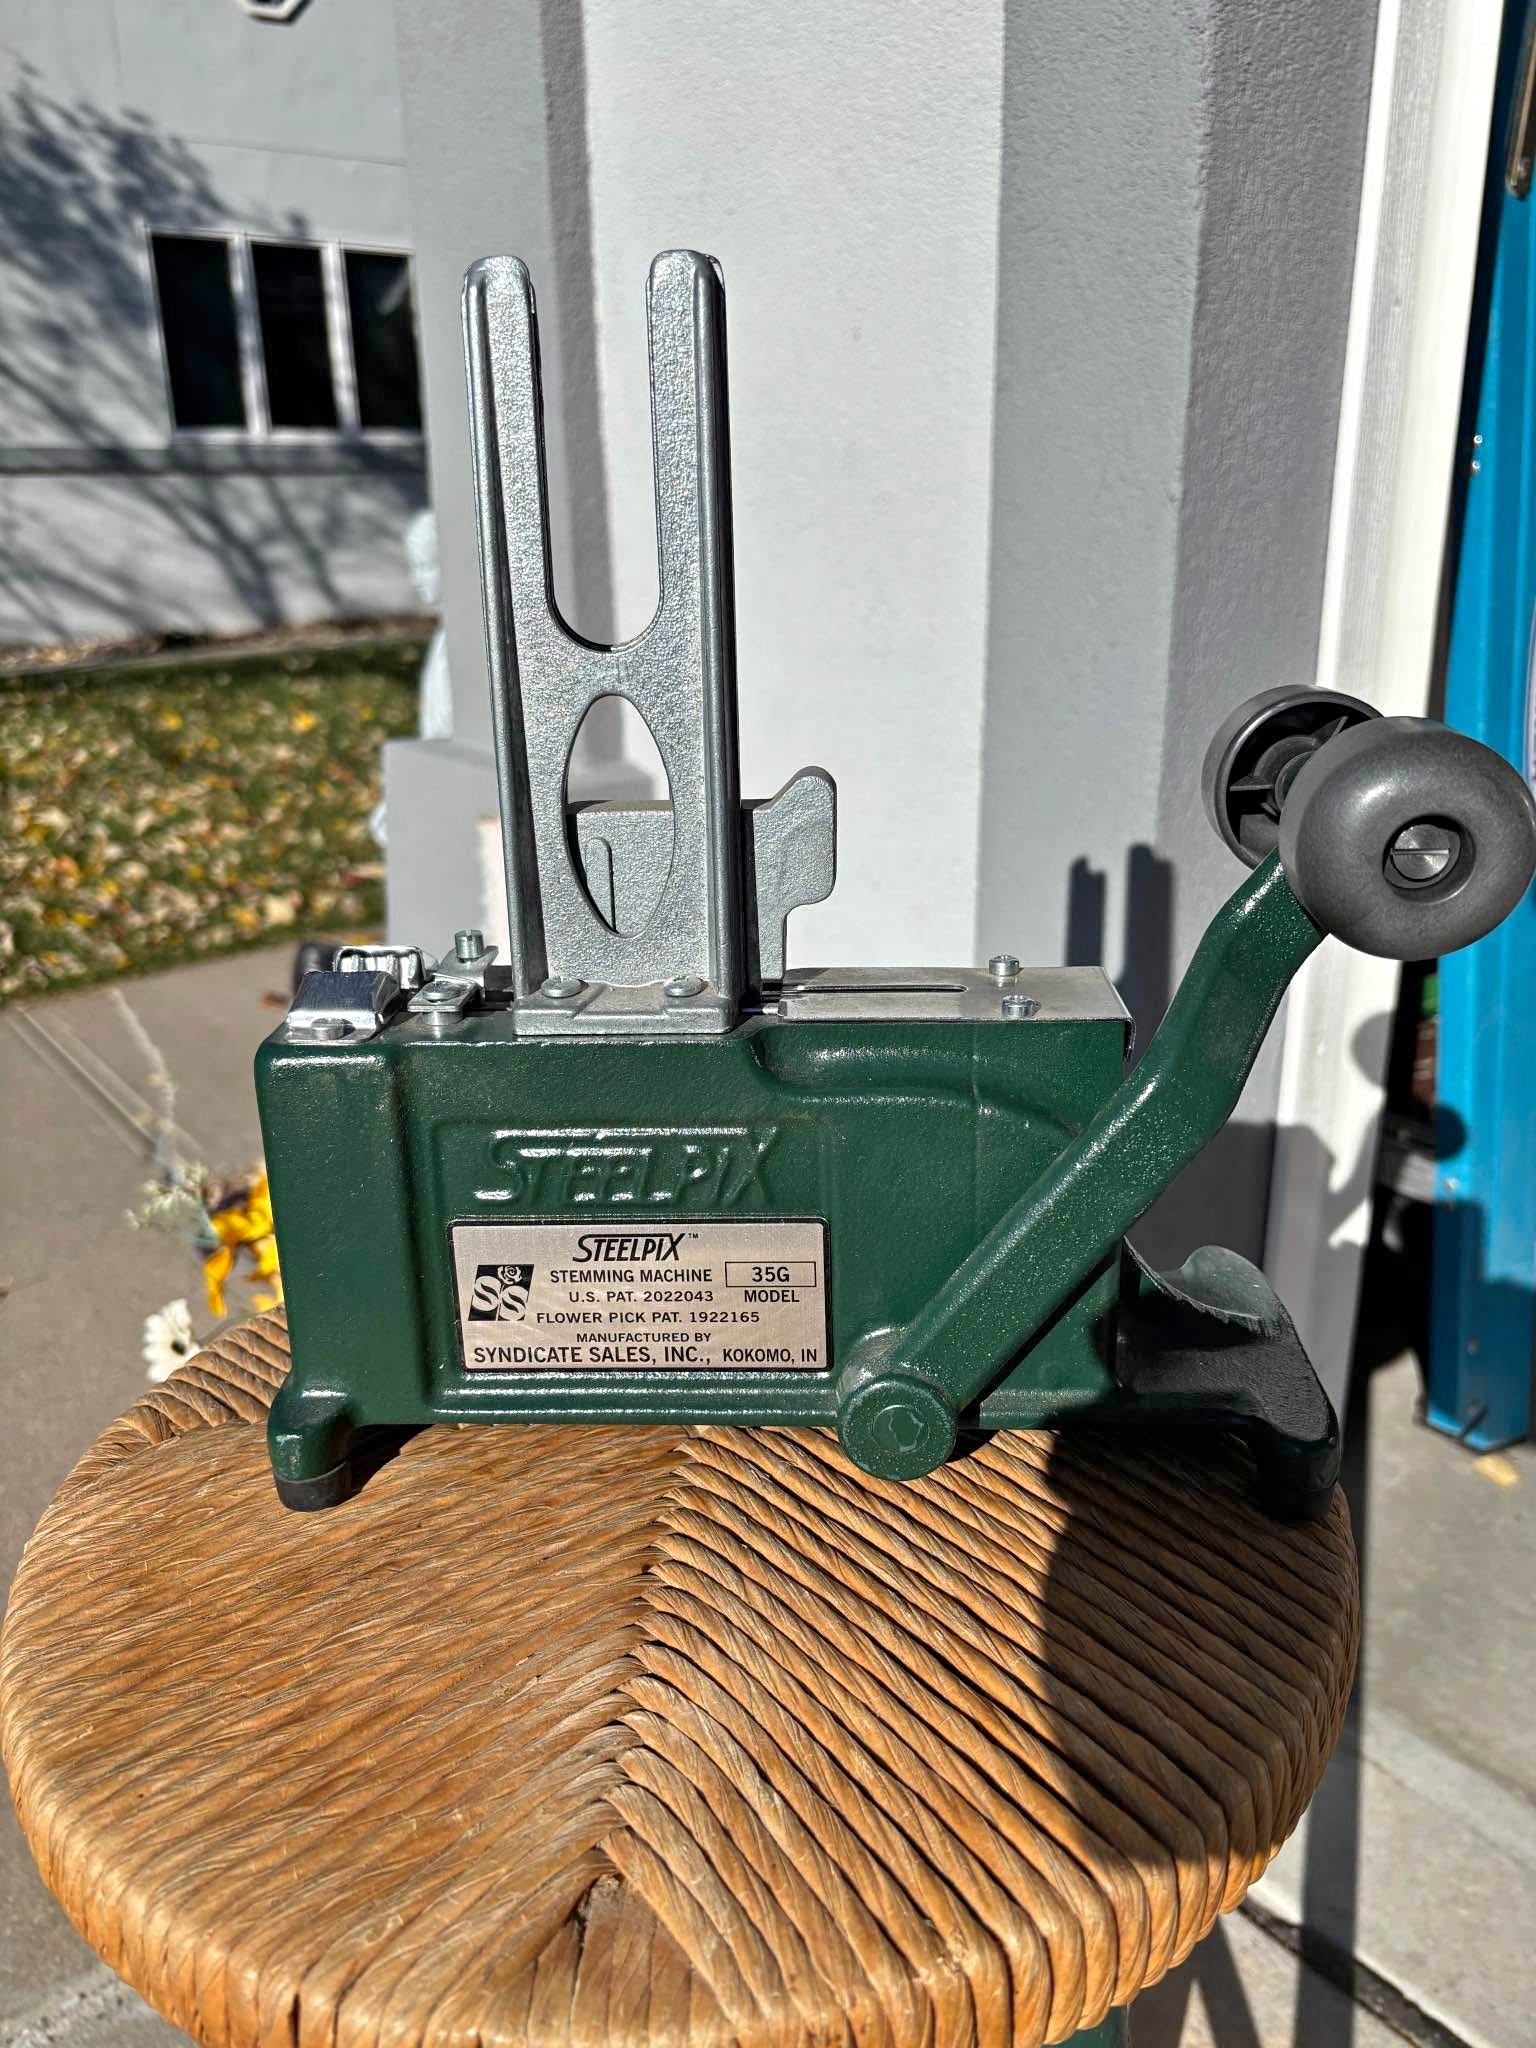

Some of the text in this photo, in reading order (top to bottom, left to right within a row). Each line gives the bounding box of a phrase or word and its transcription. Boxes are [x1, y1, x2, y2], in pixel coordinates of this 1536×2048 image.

[472, 1127, 778, 1207] STEELPIX
[550, 1269, 712, 1284] STEMMING MACHINE
[752, 1266, 790, 1282] 35G
[569, 1290, 714, 1302] U.S. PAT. 2022043
[744, 1290, 800, 1302] MODEL
[536, 1311, 760, 1324] FLOWER PICK PAT. 1922165
[576, 1332, 711, 1342] MANUFACTURED BY
[474, 1346, 817, 1365] SYNDICATE SALES, INC., KOKOMO, IN
